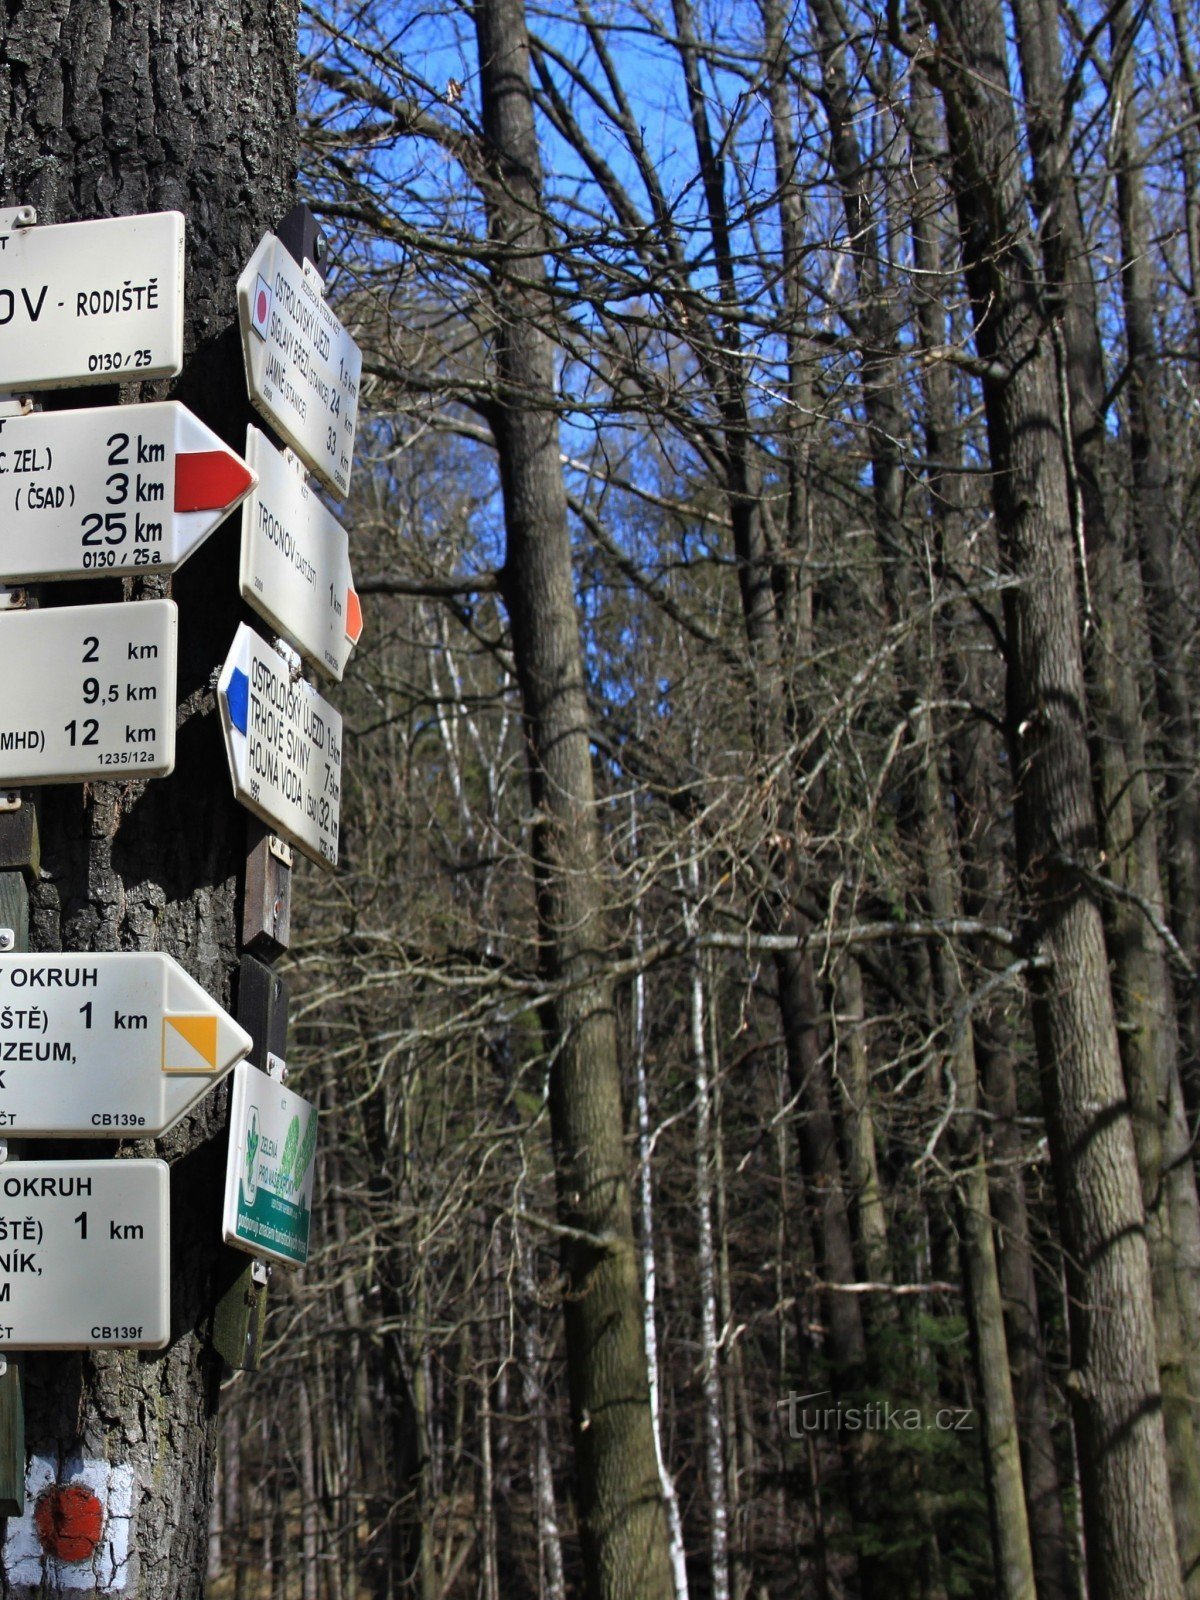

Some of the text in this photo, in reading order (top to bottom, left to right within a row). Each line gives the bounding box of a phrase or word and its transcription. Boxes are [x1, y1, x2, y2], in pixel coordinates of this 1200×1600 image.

[76, 278, 159, 318] RODIŠTĚ
[274, 271, 331, 363] OSTROLOVSKÝ ÚJEZD
[329, 387, 354, 437] 24 km
[106, 433, 166, 466] 2 km
[326, 425, 350, 473] 33 km
[105, 473, 164, 505] 3 km
[81, 512, 162, 546] 25 km
[258, 501, 296, 563] TROCNOV
[329, 582, 334, 608] 1
[82, 636, 100, 663] 2
[127, 642, 159, 661] km
[82, 677, 119, 706] 9,5
[126, 684, 158, 702] km
[251, 656, 302, 729] OSTROLOVSKÝ
[302, 698, 325, 750] ÚJEZD
[64, 719, 100, 747] 12
[125, 725, 156, 744] km
[250, 691, 284, 752] TRHOVÉ
[286, 728, 311, 775] SVINY
[97, 751, 155, 766] 1235/12a
[248, 734, 280, 788] HOJNÁ
[280, 761, 303, 811] VODA
[318, 796, 330, 832] 32
[10, 967, 98, 988] OKRUH
[78, 1001, 93, 1030] 1
[113, 1010, 148, 1030] km
[91, 1112, 146, 1126] CB139e
[3, 1177, 92, 1198] OKRUH
[73, 1210, 88, 1240] 1
[109, 1220, 144, 1240] km
[90, 1325, 143, 1340] CB139f
